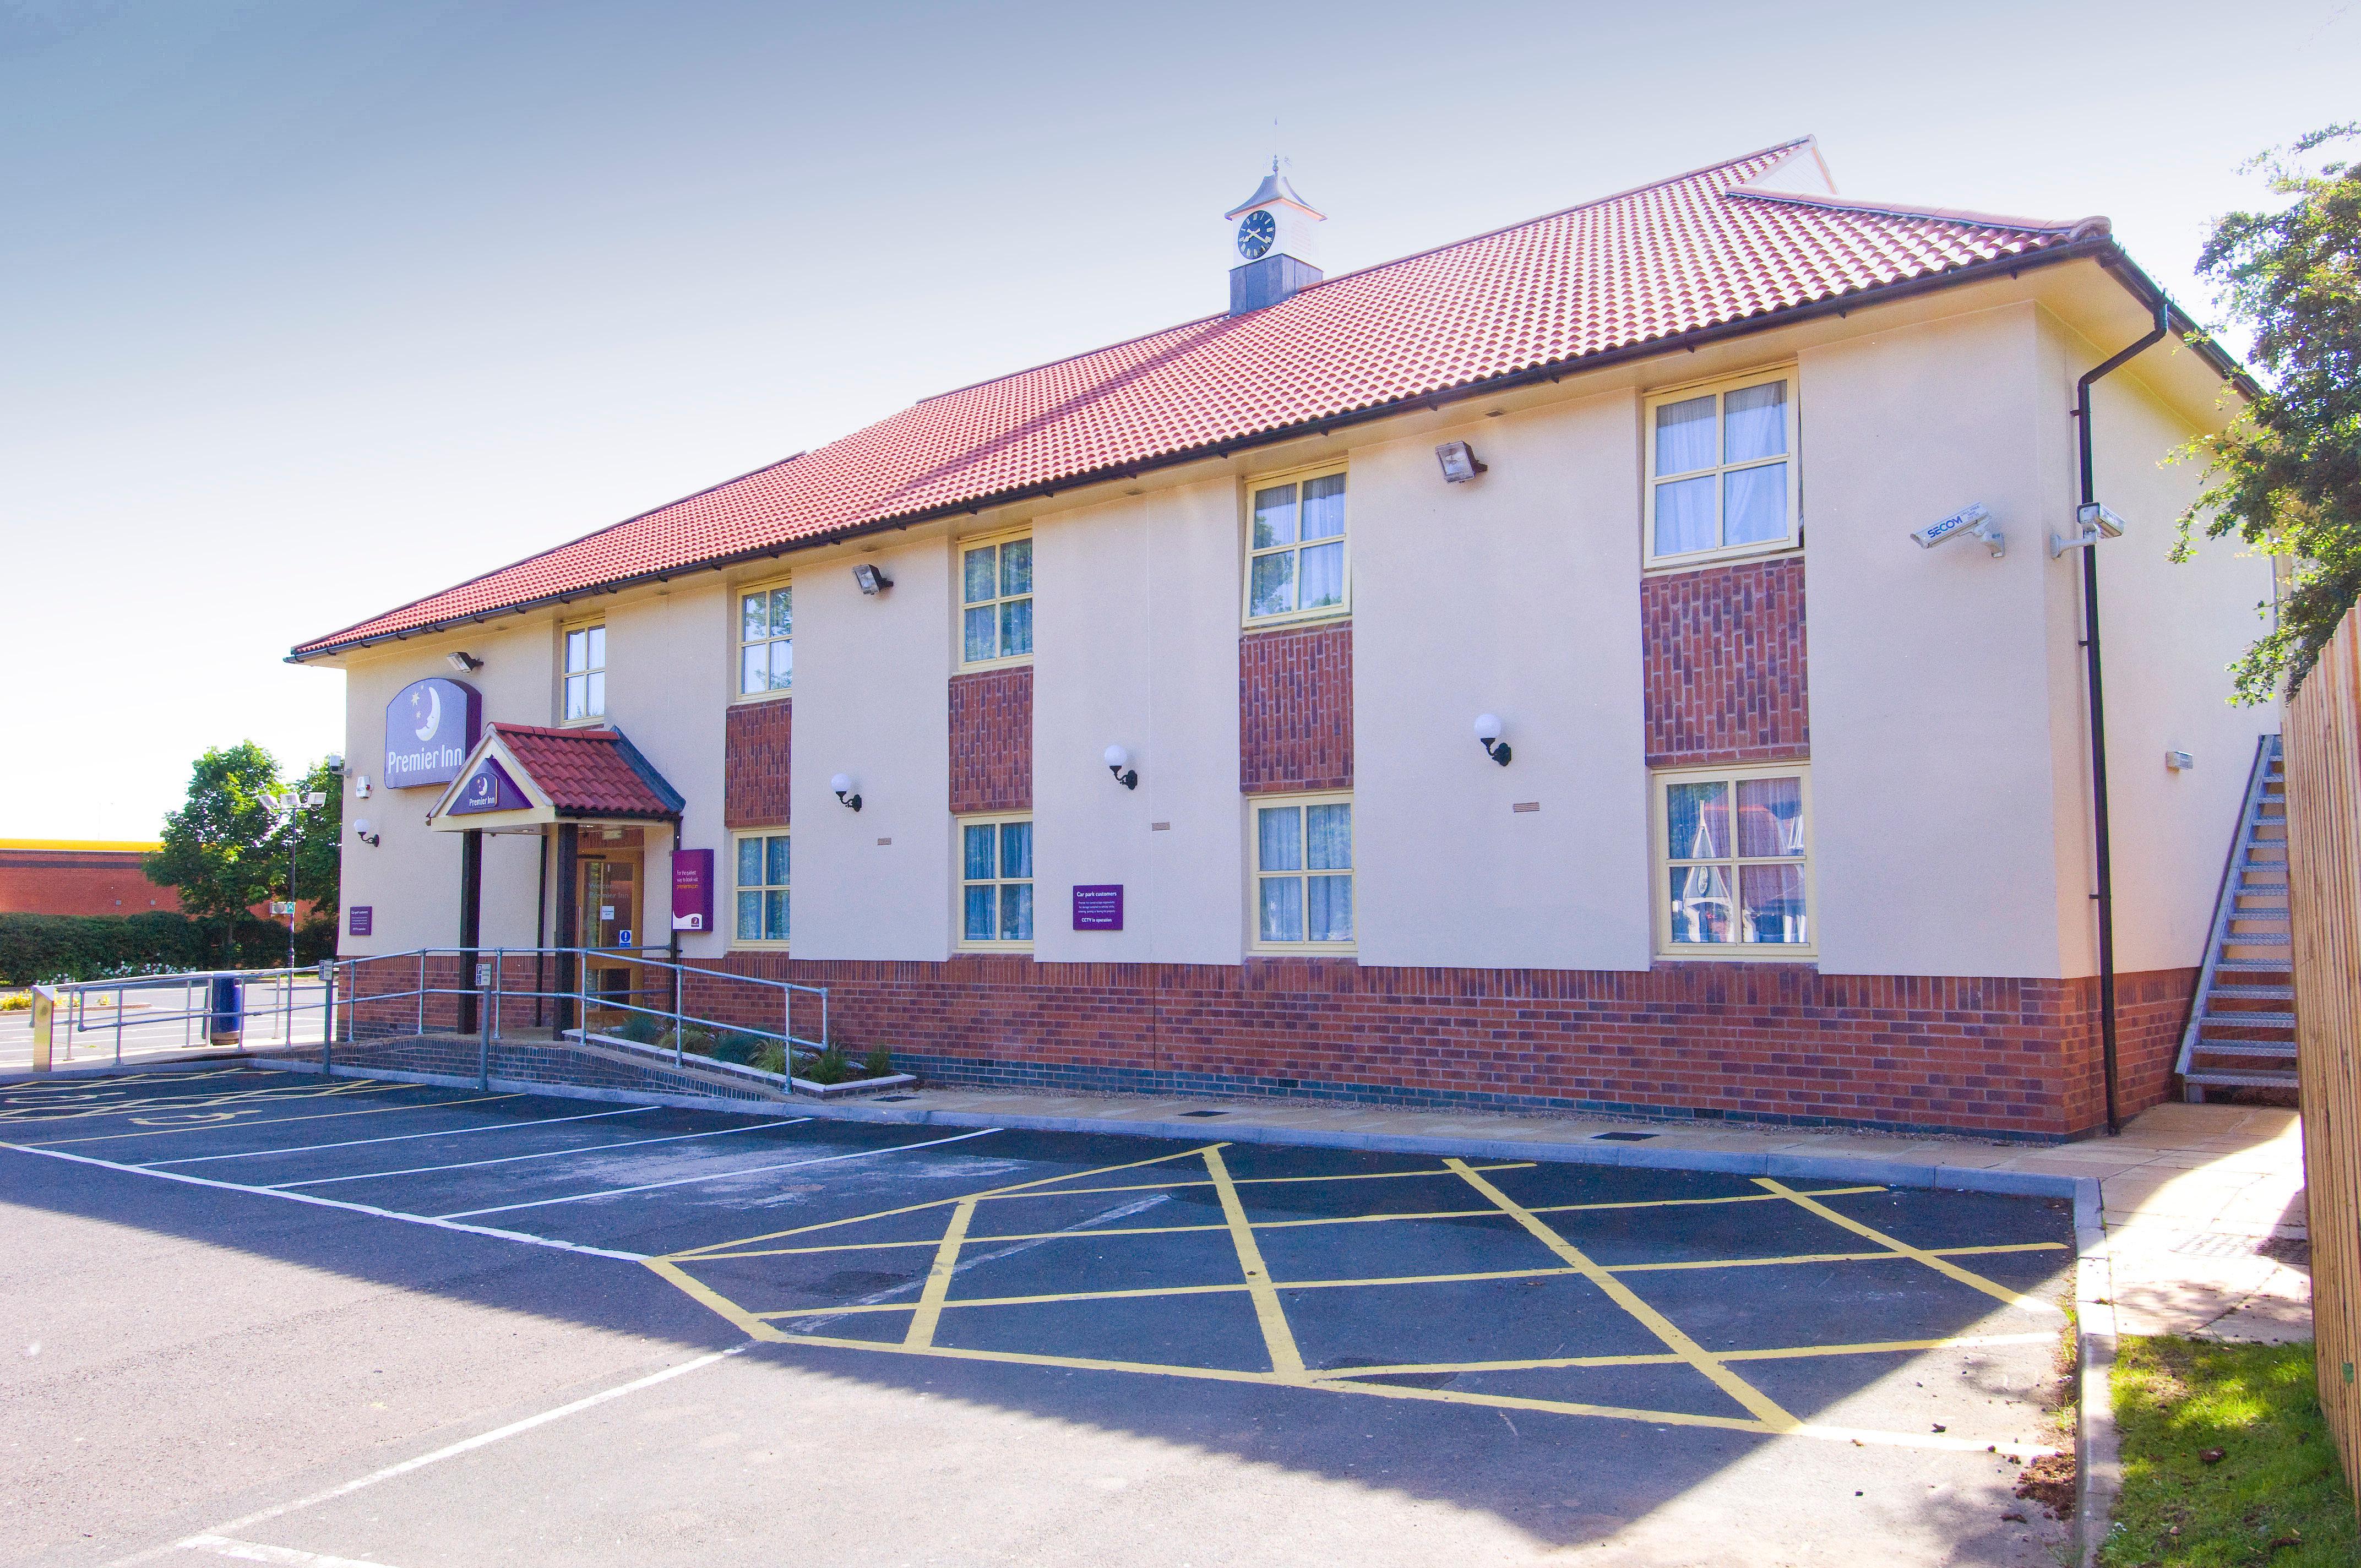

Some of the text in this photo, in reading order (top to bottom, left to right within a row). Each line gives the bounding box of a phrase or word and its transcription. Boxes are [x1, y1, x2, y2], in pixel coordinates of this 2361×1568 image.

[1927, 516, 1963, 538] SECOM
[388, 744, 462, 774] Premier Inn
[469, 797, 487, 807] Premier
